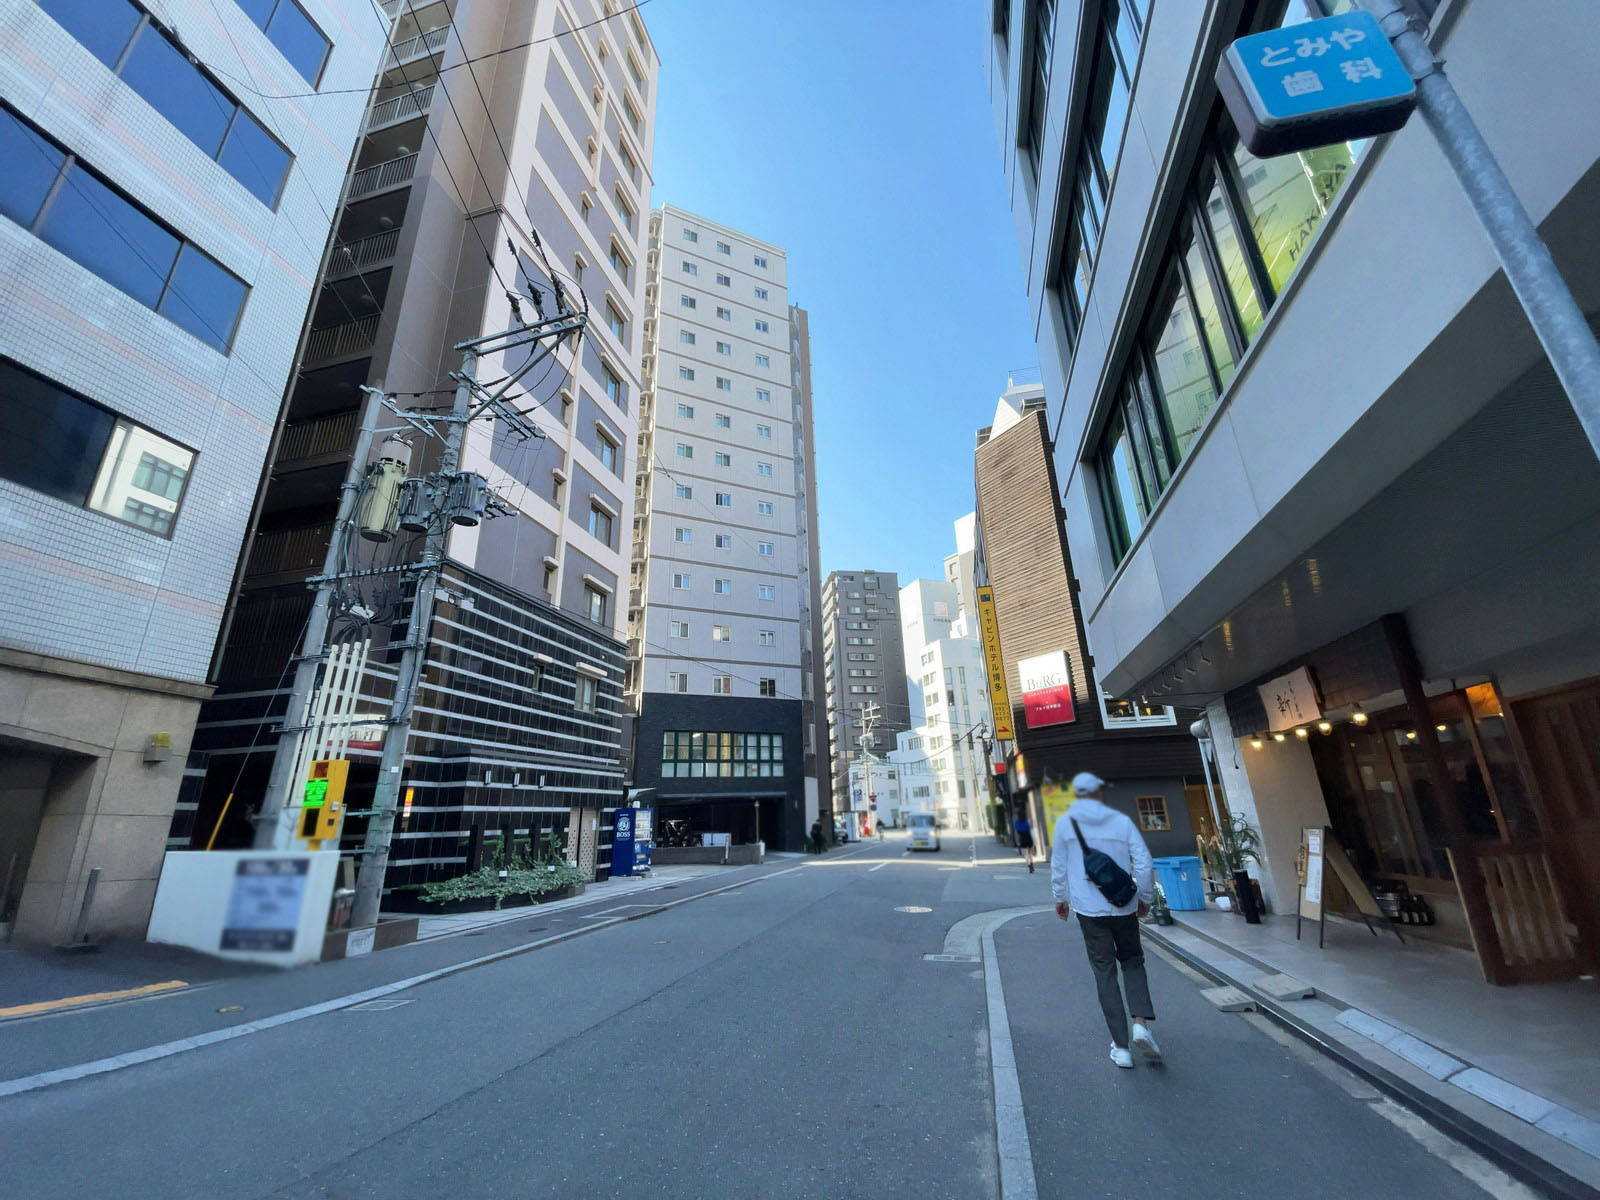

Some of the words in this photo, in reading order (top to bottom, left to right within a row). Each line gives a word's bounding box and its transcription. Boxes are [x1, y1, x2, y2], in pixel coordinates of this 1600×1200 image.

[1261, 27, 1366, 67] とみや
[1281, 56, 1383, 97] 歯科
[984, 609, 1002, 692] キャビンホテル博多
